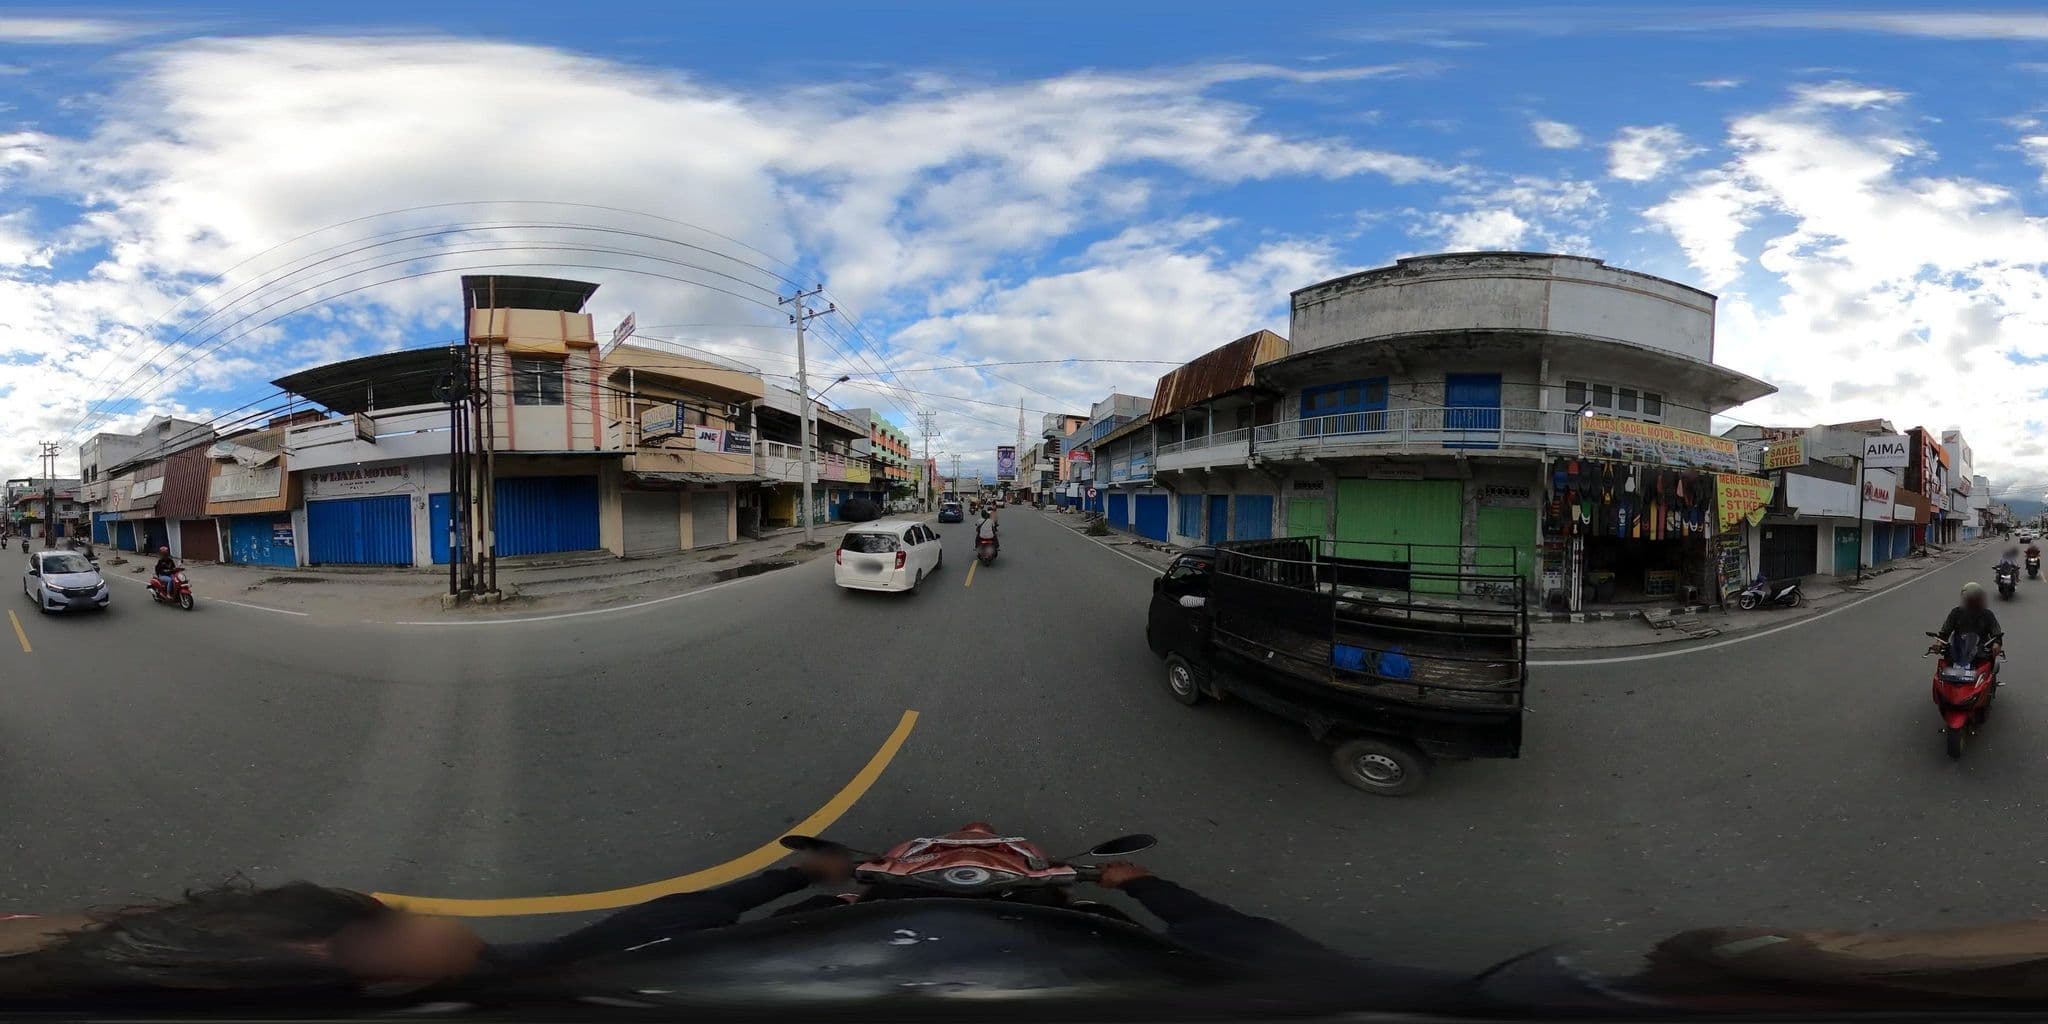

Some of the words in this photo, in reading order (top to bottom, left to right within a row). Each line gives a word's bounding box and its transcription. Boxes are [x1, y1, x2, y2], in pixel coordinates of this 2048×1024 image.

[1584, 418, 1617, 431] VARIASI
[1619, 420, 1647, 435] SADEL
[1648, 425, 1674, 440] MOTOR
[699, 431, 717, 441] JNE
[1770, 445, 1800, 458] SADEL
[1867, 443, 1905, 455] AIMA
[1770, 455, 1801, 468] STIKER
[319, 469, 362, 482] WIJAYA
[1719, 474, 1771, 488] MENGERJAKAN
[1725, 488, 1761, 500] SADEL
